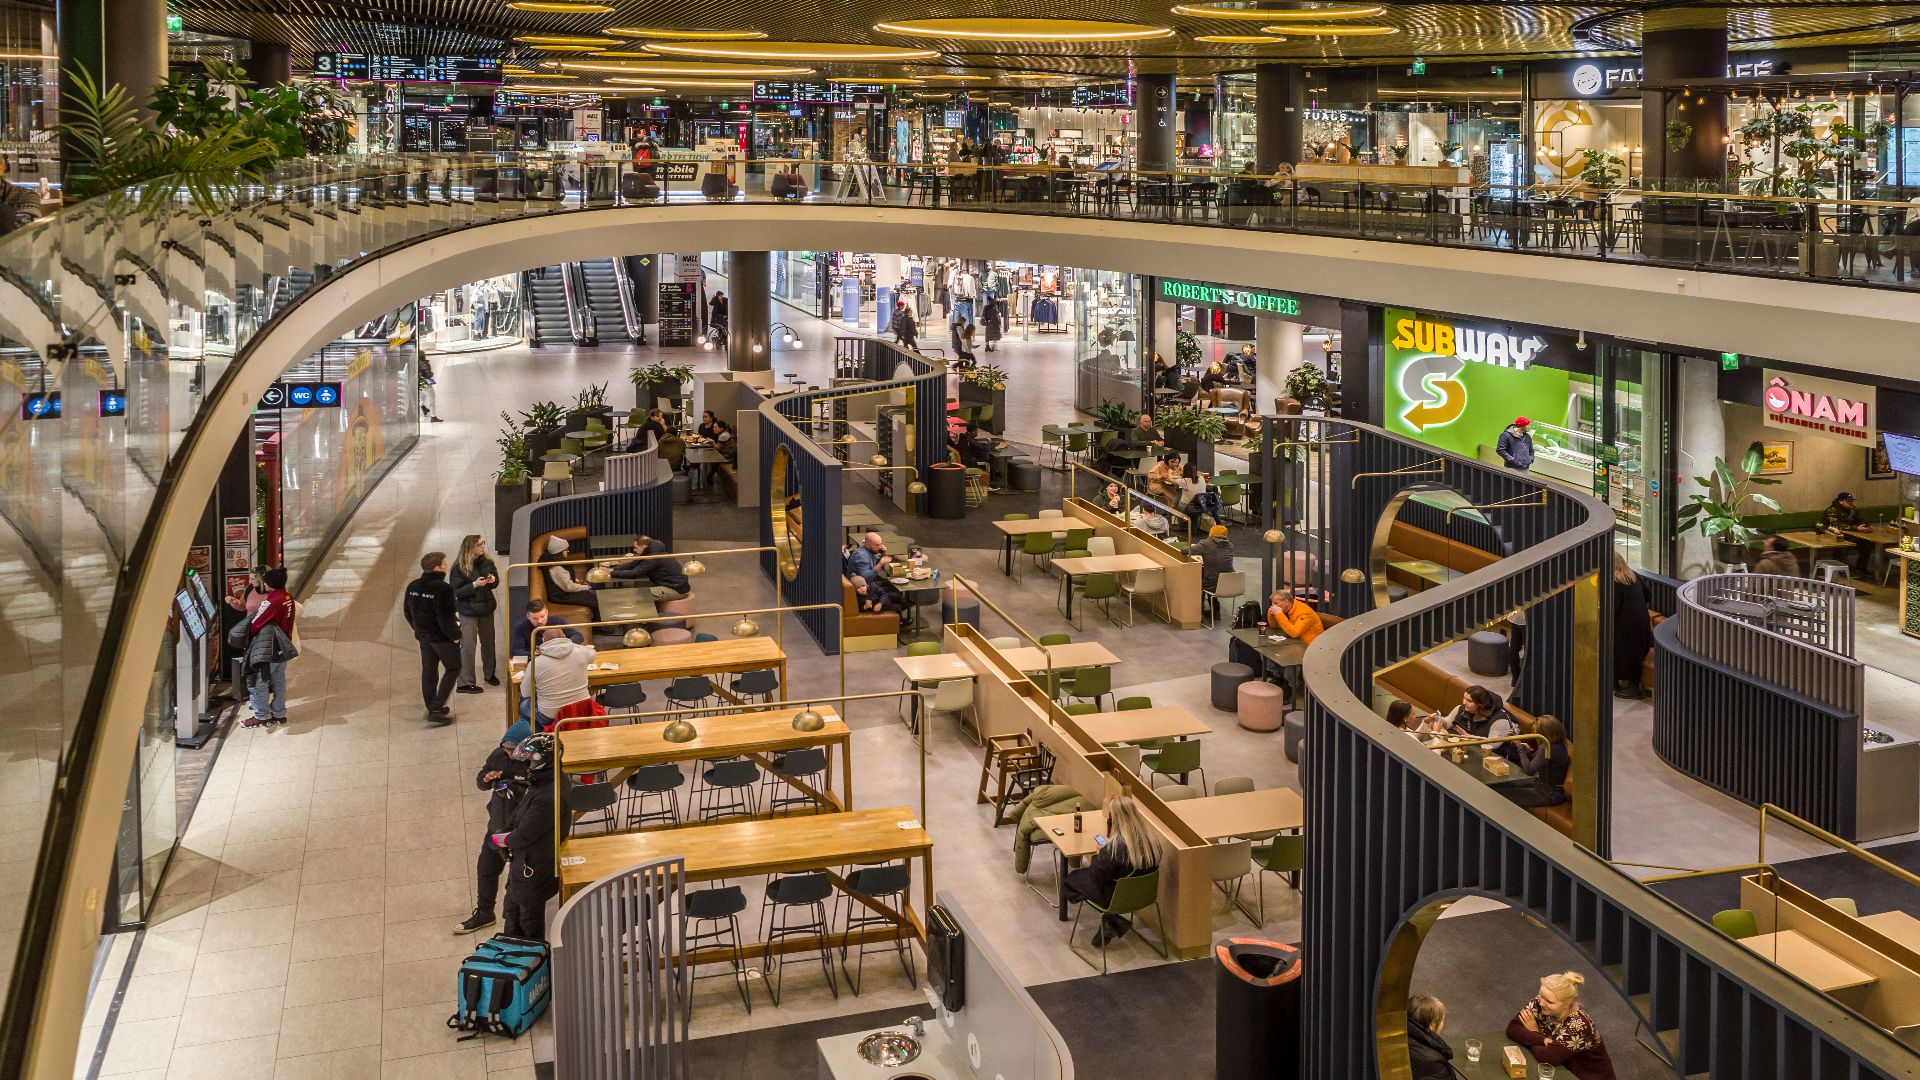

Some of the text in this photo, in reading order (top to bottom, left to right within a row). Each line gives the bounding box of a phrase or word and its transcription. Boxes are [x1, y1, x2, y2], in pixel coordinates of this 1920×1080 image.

[318, 56, 331, 71] 3
[497, 94, 505, 102] 3
[1303, 112, 1365, 121] TUALS...
[660, 284, 667, 292] 2
[1163, 281, 1298, 315] ROBERT'S COFFEE
[1391, 318, 1548, 371] SUBWAY
[1765, 377, 1867, 427] ÔNAM
[1829, 425, 1868, 439] CUISINE
